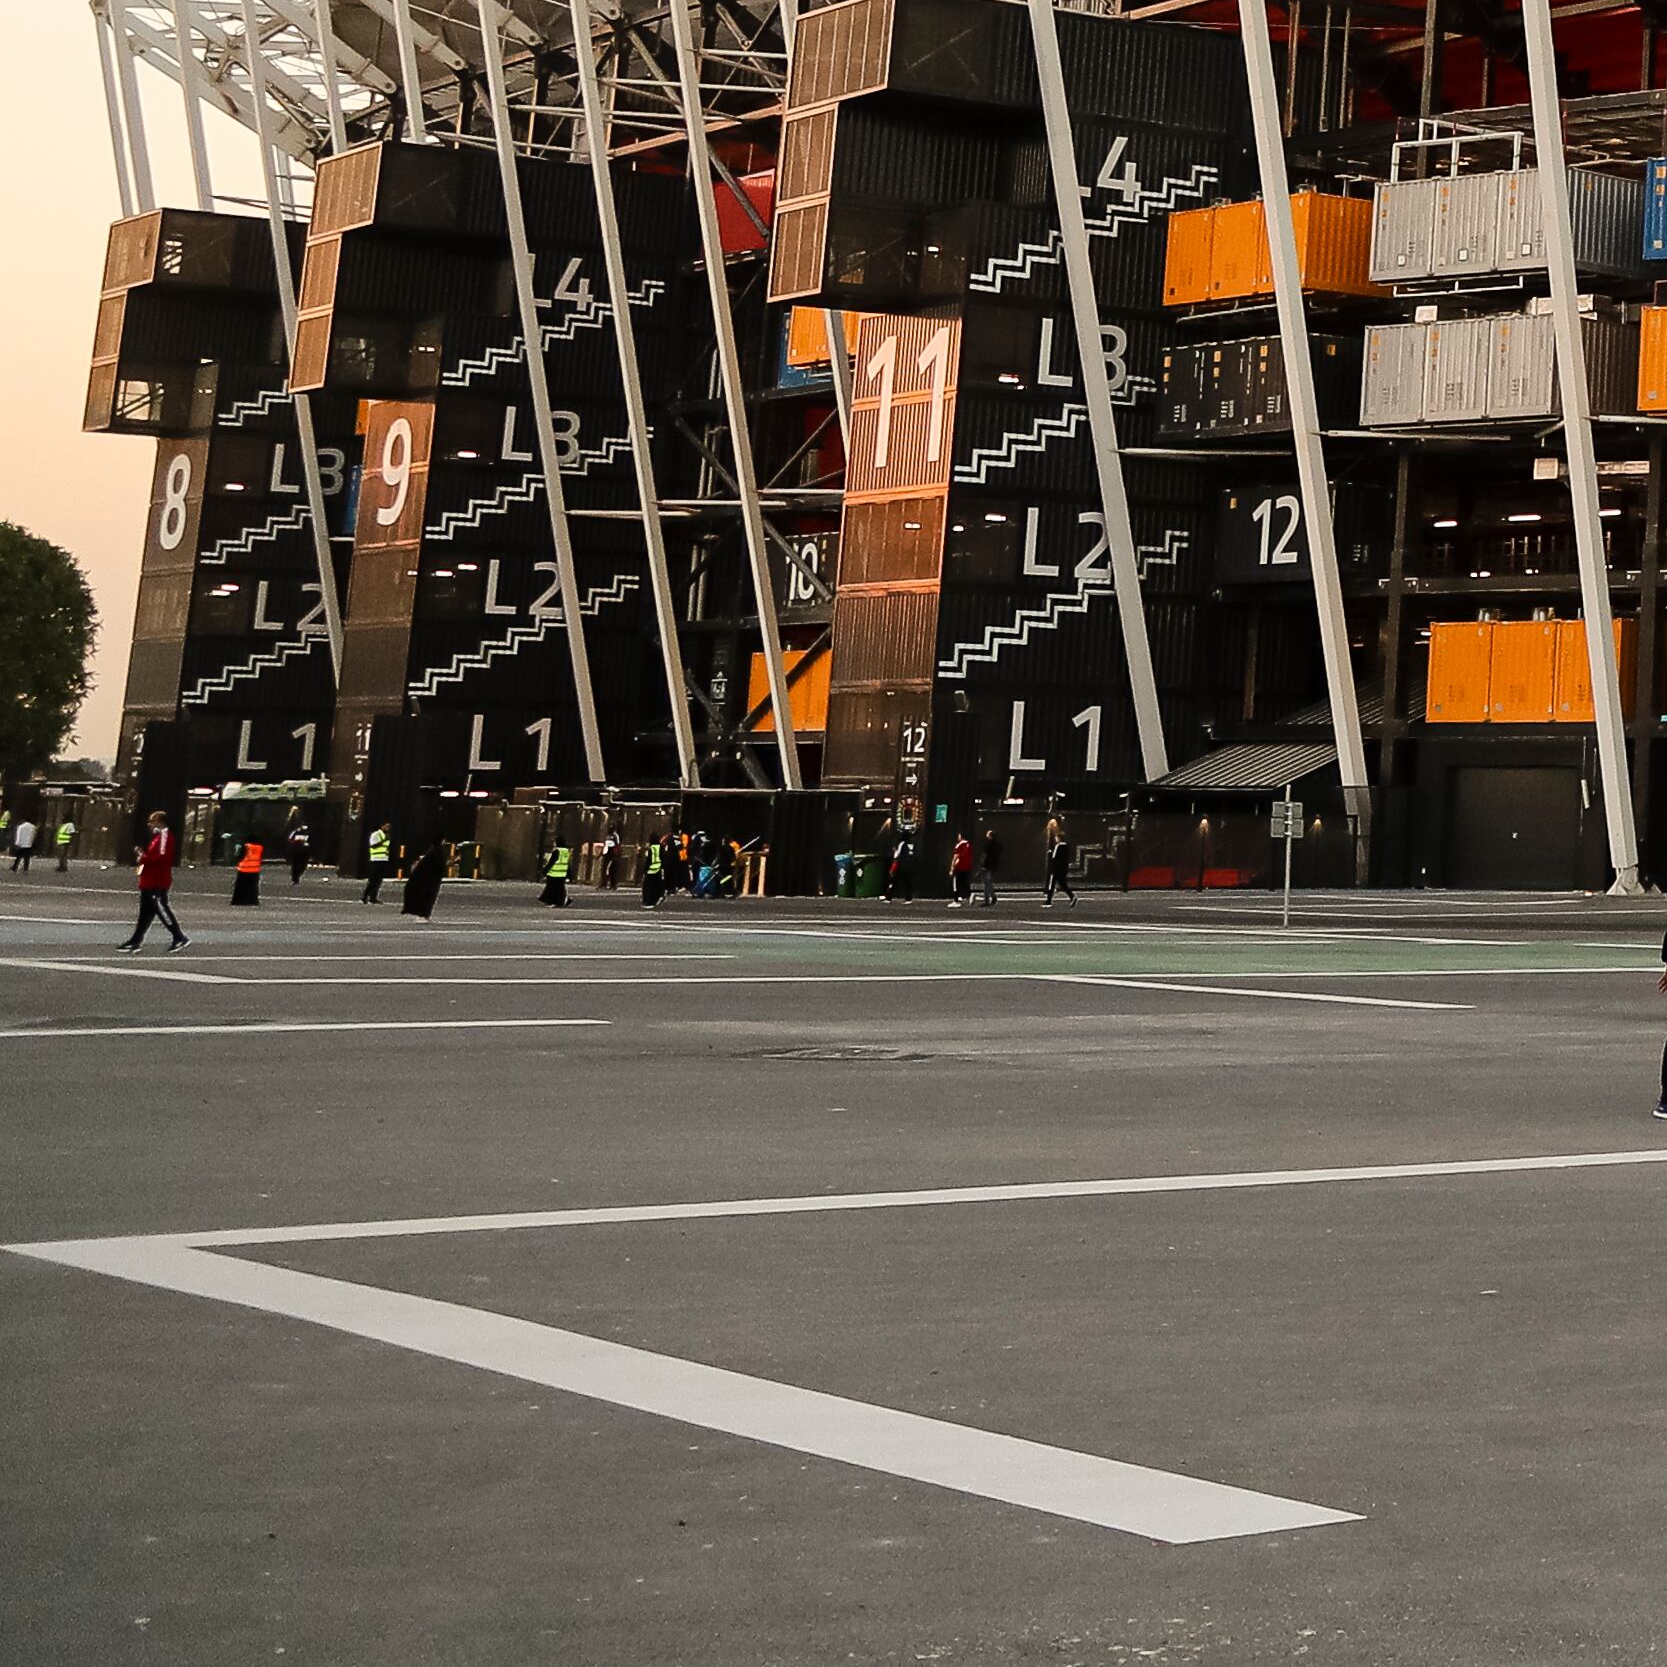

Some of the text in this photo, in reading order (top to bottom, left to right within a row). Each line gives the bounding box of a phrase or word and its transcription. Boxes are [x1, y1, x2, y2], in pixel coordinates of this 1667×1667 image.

[1037, 317, 1128, 390] L3
[865, 326, 951, 470] 11
[270, 442, 346, 496] L3
[377, 417, 413, 526] 9
[159, 453, 192, 551] 8
[1252, 494, 1300, 565] 12
[786, 541, 819, 601] 10
[1023, 506, 1112, 579] L2
[254, 580, 328, 632] L2
[485, 559, 563, 616] L2
[236, 719, 317, 771] L1
[469, 713, 552, 771] L1
[903, 727, 926, 753] 12
[1007, 700, 1103, 772] L1
